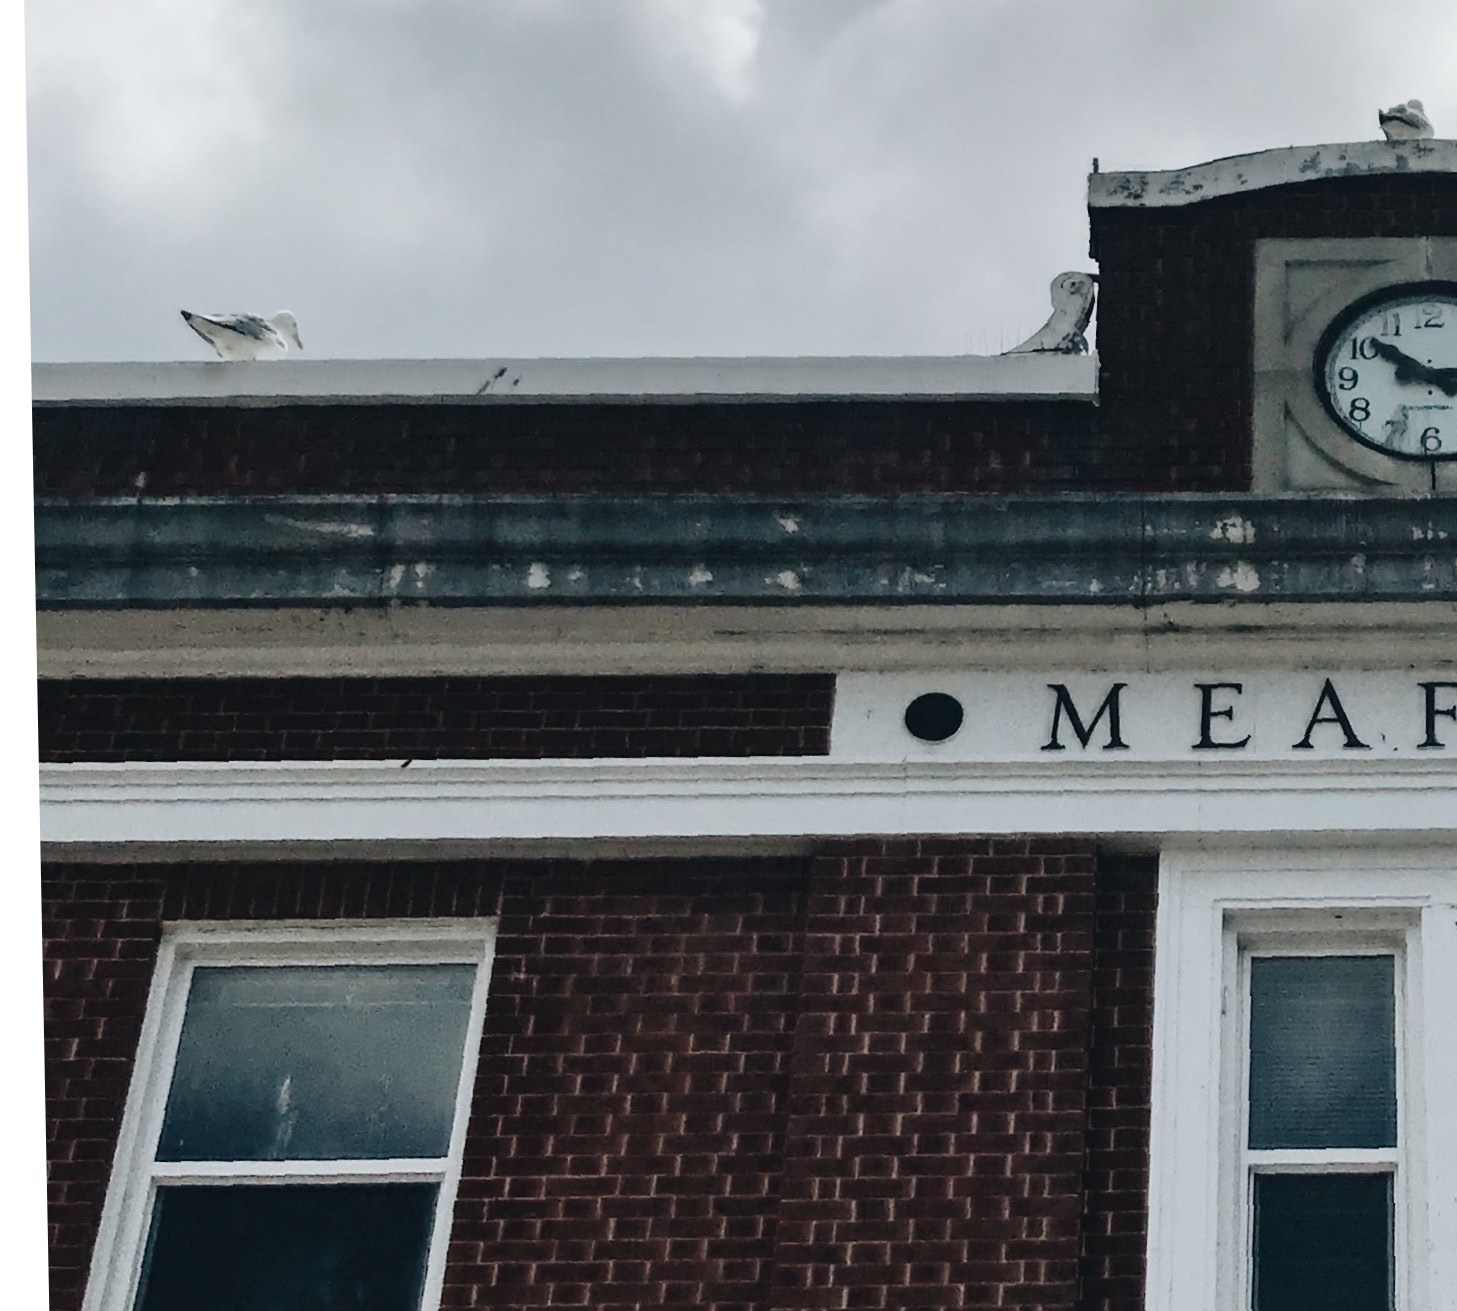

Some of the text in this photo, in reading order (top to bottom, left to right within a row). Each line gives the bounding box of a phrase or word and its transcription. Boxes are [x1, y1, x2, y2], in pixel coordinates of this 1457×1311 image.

[1380, 312, 1402, 336] 11
[1414, 303, 1445, 329] 12
[1350, 337, 1380, 360] 10
[1338, 366, 1359, 391] 9
[1349, 397, 1371, 421] 8
[1420, 426, 1442, 452] 6
